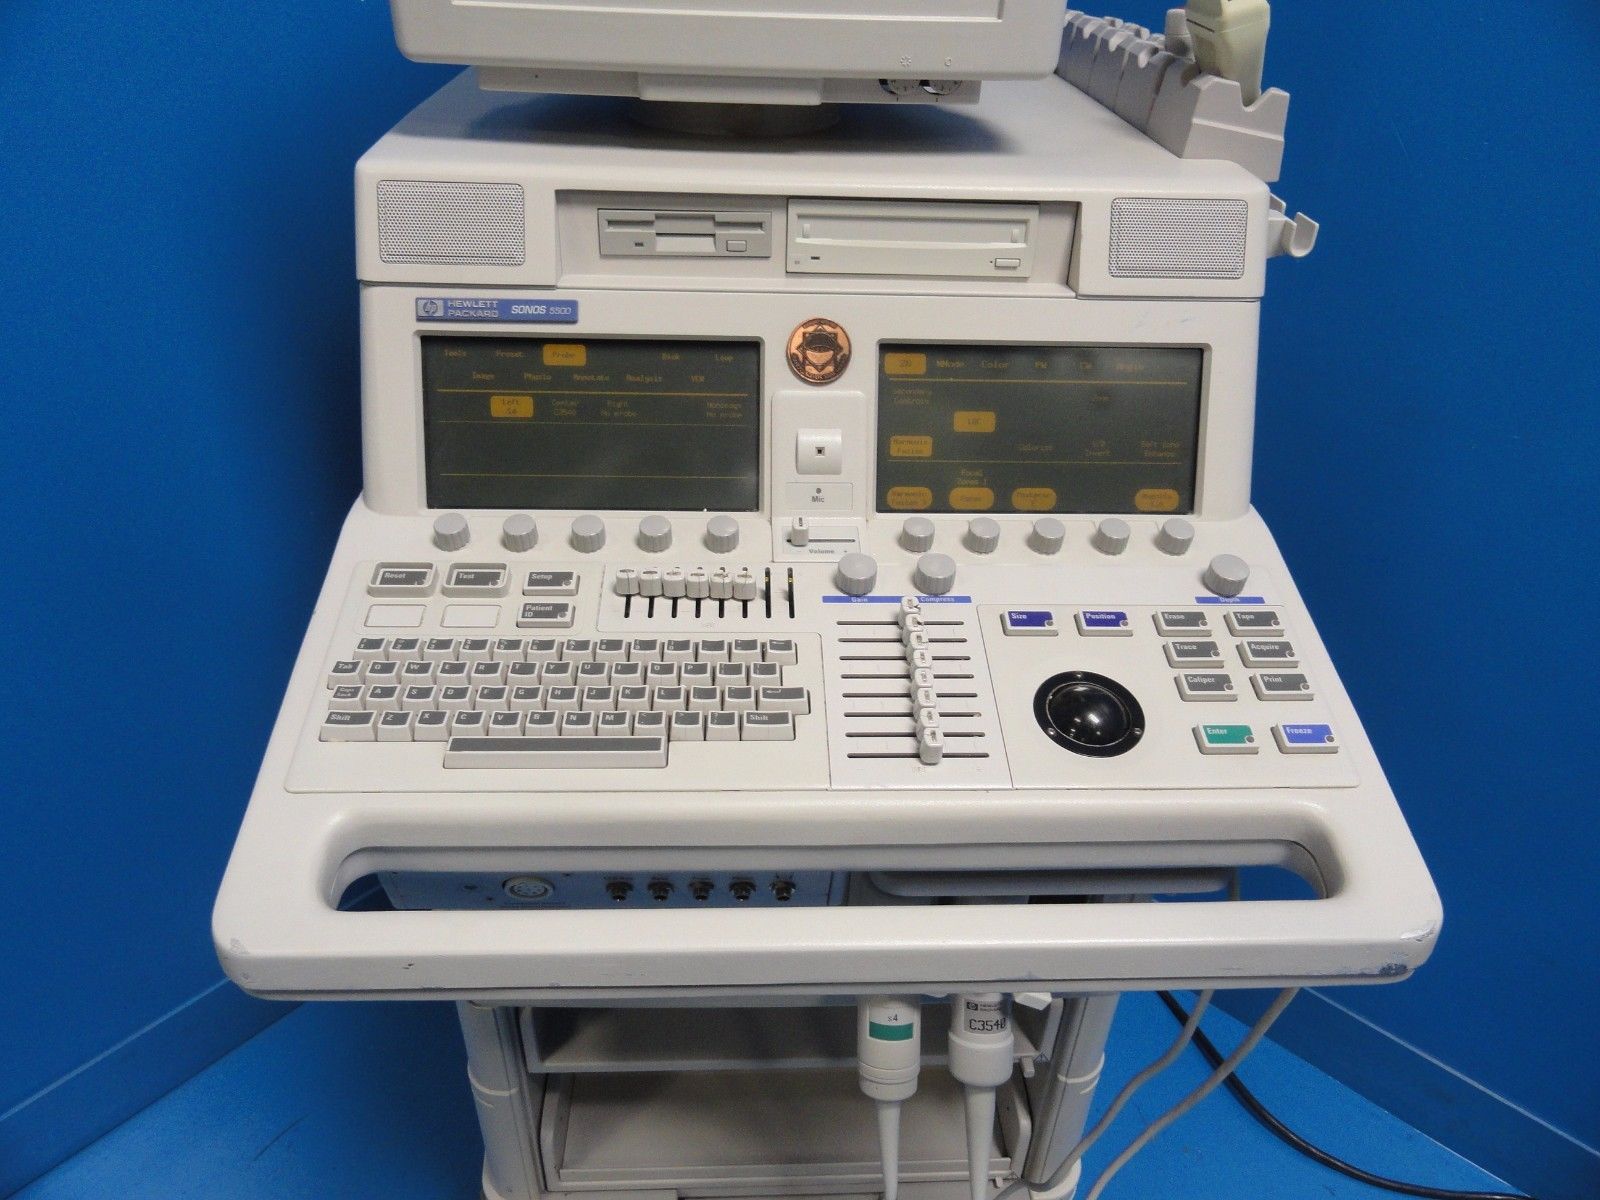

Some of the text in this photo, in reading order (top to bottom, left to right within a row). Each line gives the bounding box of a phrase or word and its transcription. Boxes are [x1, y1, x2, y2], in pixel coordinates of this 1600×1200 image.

[448, 300, 498, 308] HEWLETT
[511, 305, 546, 314] SONOS
[448, 310, 498, 318] PACKARD
[1206, 727, 1227, 735] Enter
